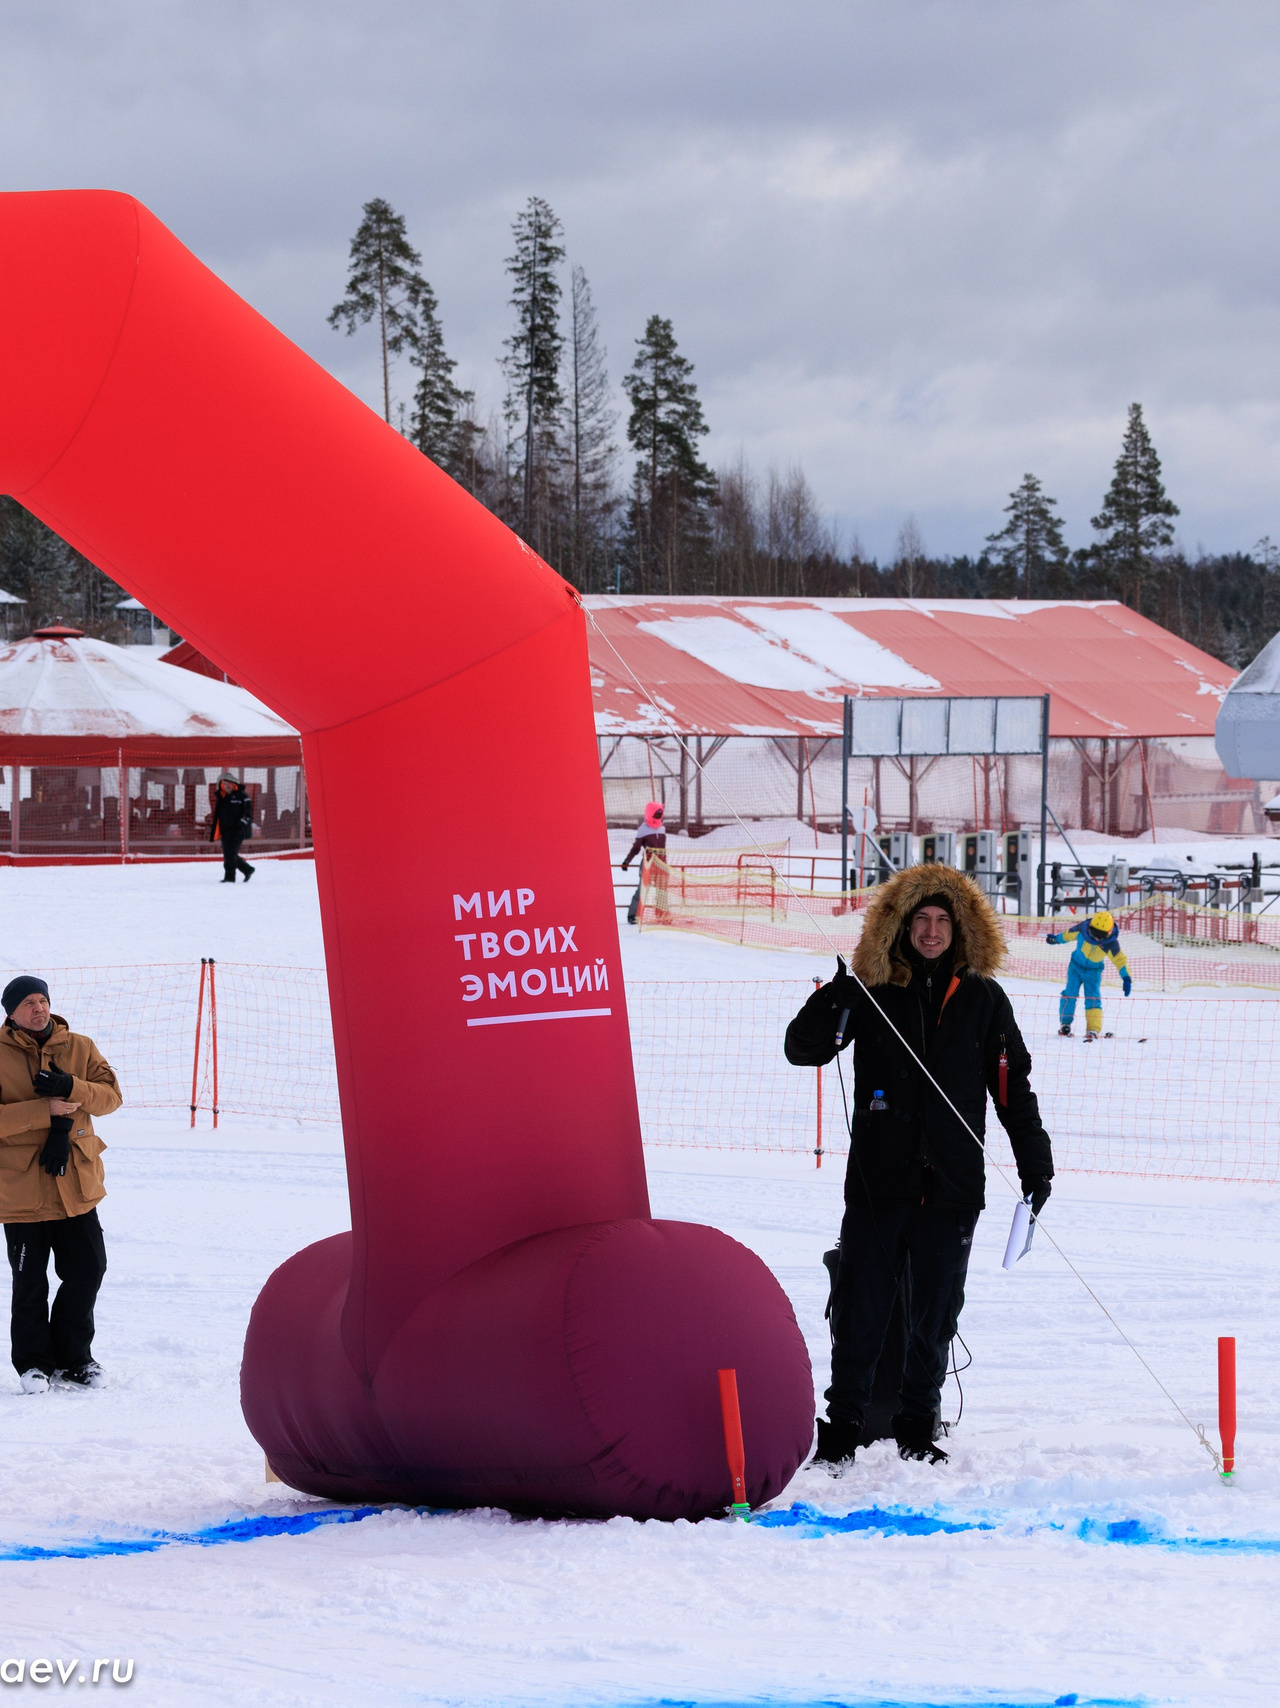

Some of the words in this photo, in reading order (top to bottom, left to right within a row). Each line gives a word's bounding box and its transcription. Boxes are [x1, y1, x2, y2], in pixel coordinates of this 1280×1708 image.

[453, 888, 535, 921] МИР
[454, 925, 579, 961] ТВОИХ
[460, 958, 609, 1002] ЭМОЦИЙ
